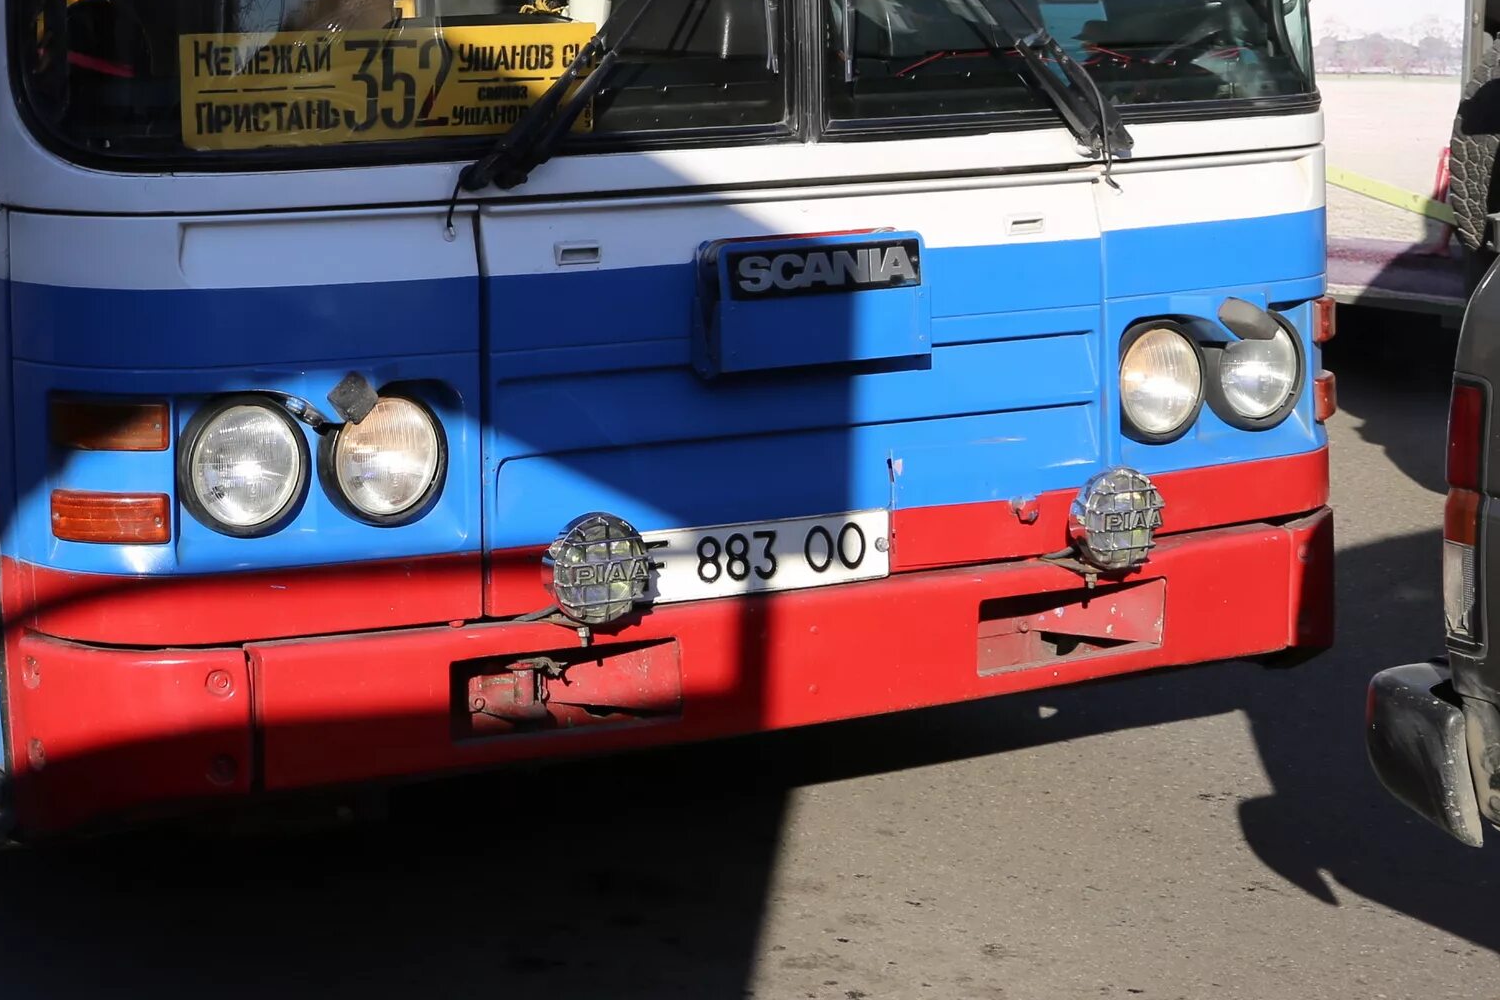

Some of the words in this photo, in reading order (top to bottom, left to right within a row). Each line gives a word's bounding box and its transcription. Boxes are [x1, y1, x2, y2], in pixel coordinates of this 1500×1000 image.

[343, 38, 453, 131] 352
[738, 246, 918, 292] SCANIA
[1105, 509, 1163, 531] PIAA
[574, 560, 650, 585] PIAA
[697, 530, 778, 584] 883
